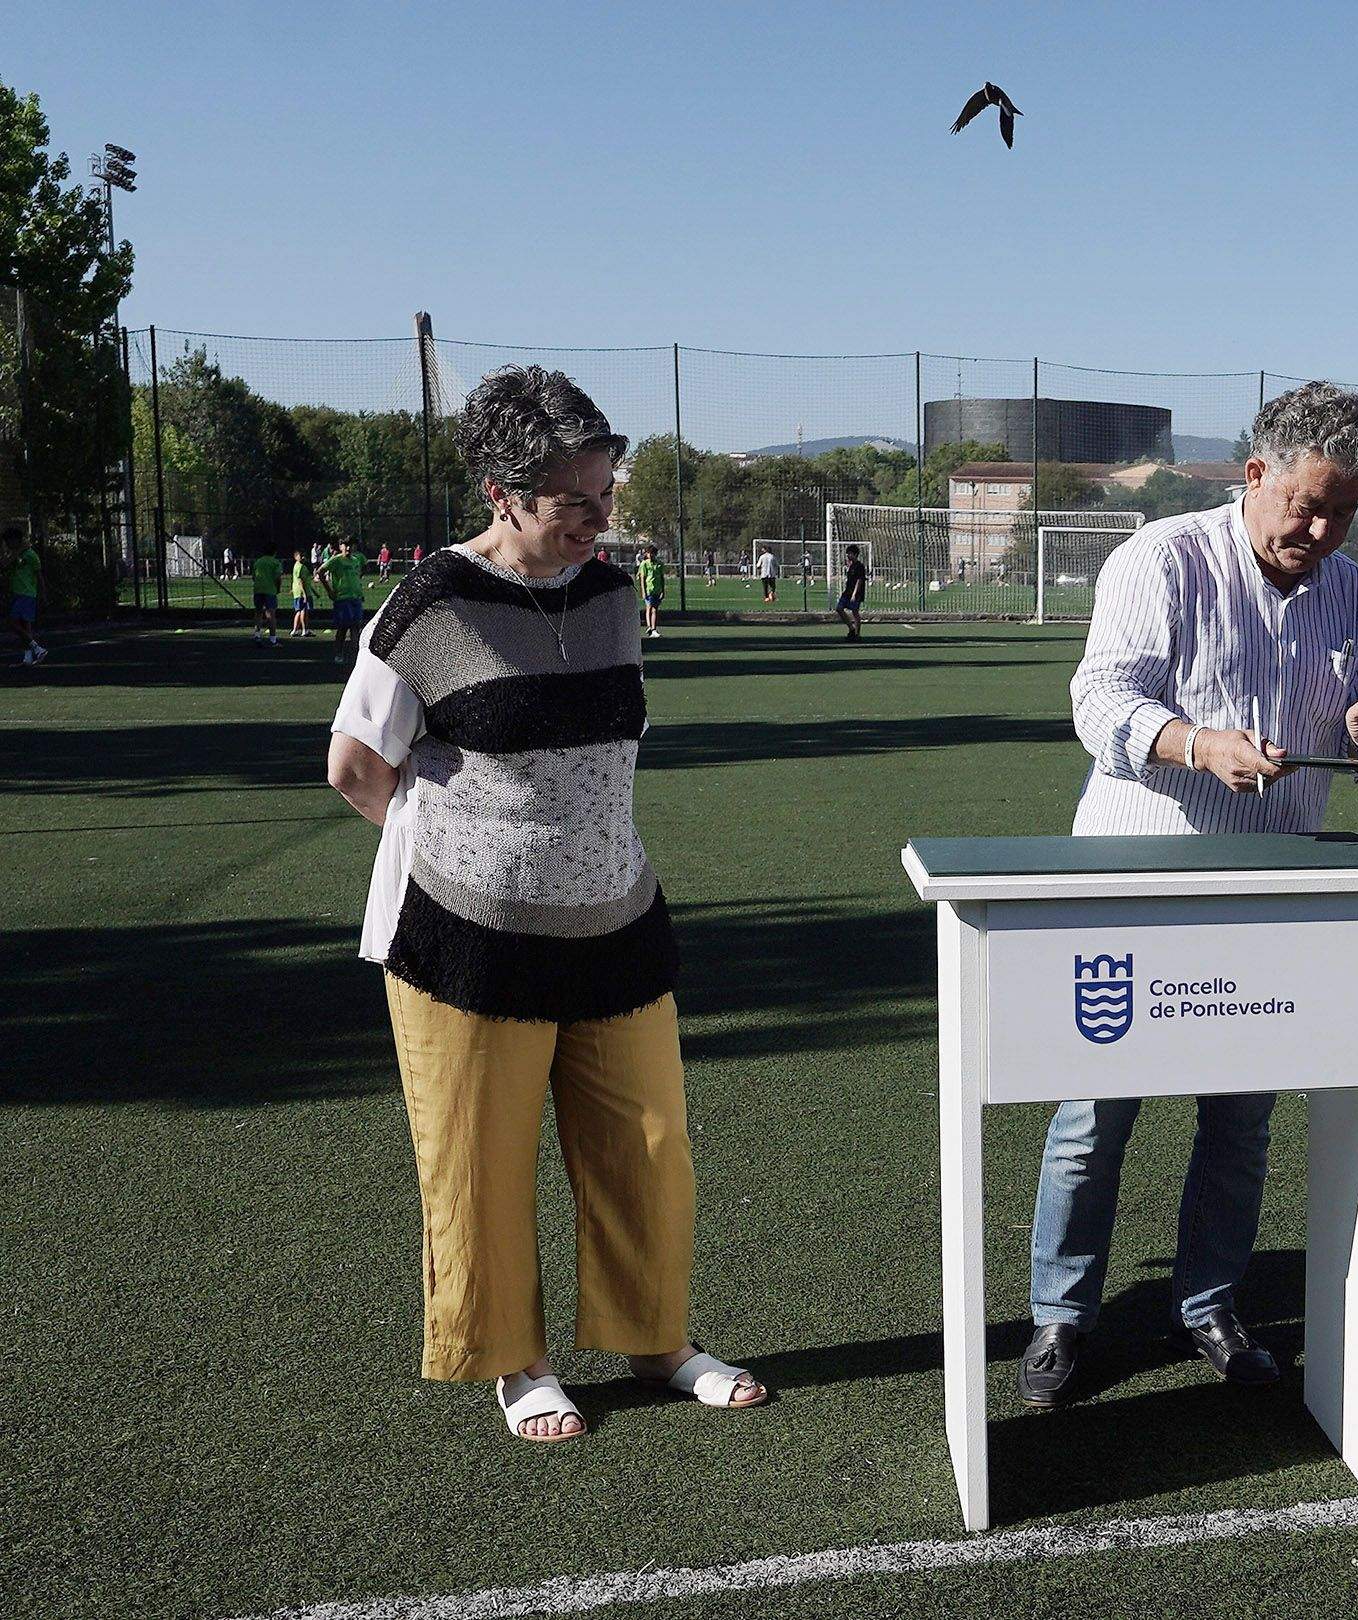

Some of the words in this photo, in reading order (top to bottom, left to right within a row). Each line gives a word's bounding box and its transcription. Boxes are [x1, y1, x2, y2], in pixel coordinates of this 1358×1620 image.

[1149, 977, 1237, 997] Concello
[1149, 1001, 1176, 1019] de
[1180, 997, 1295, 1018] Pontevedra
